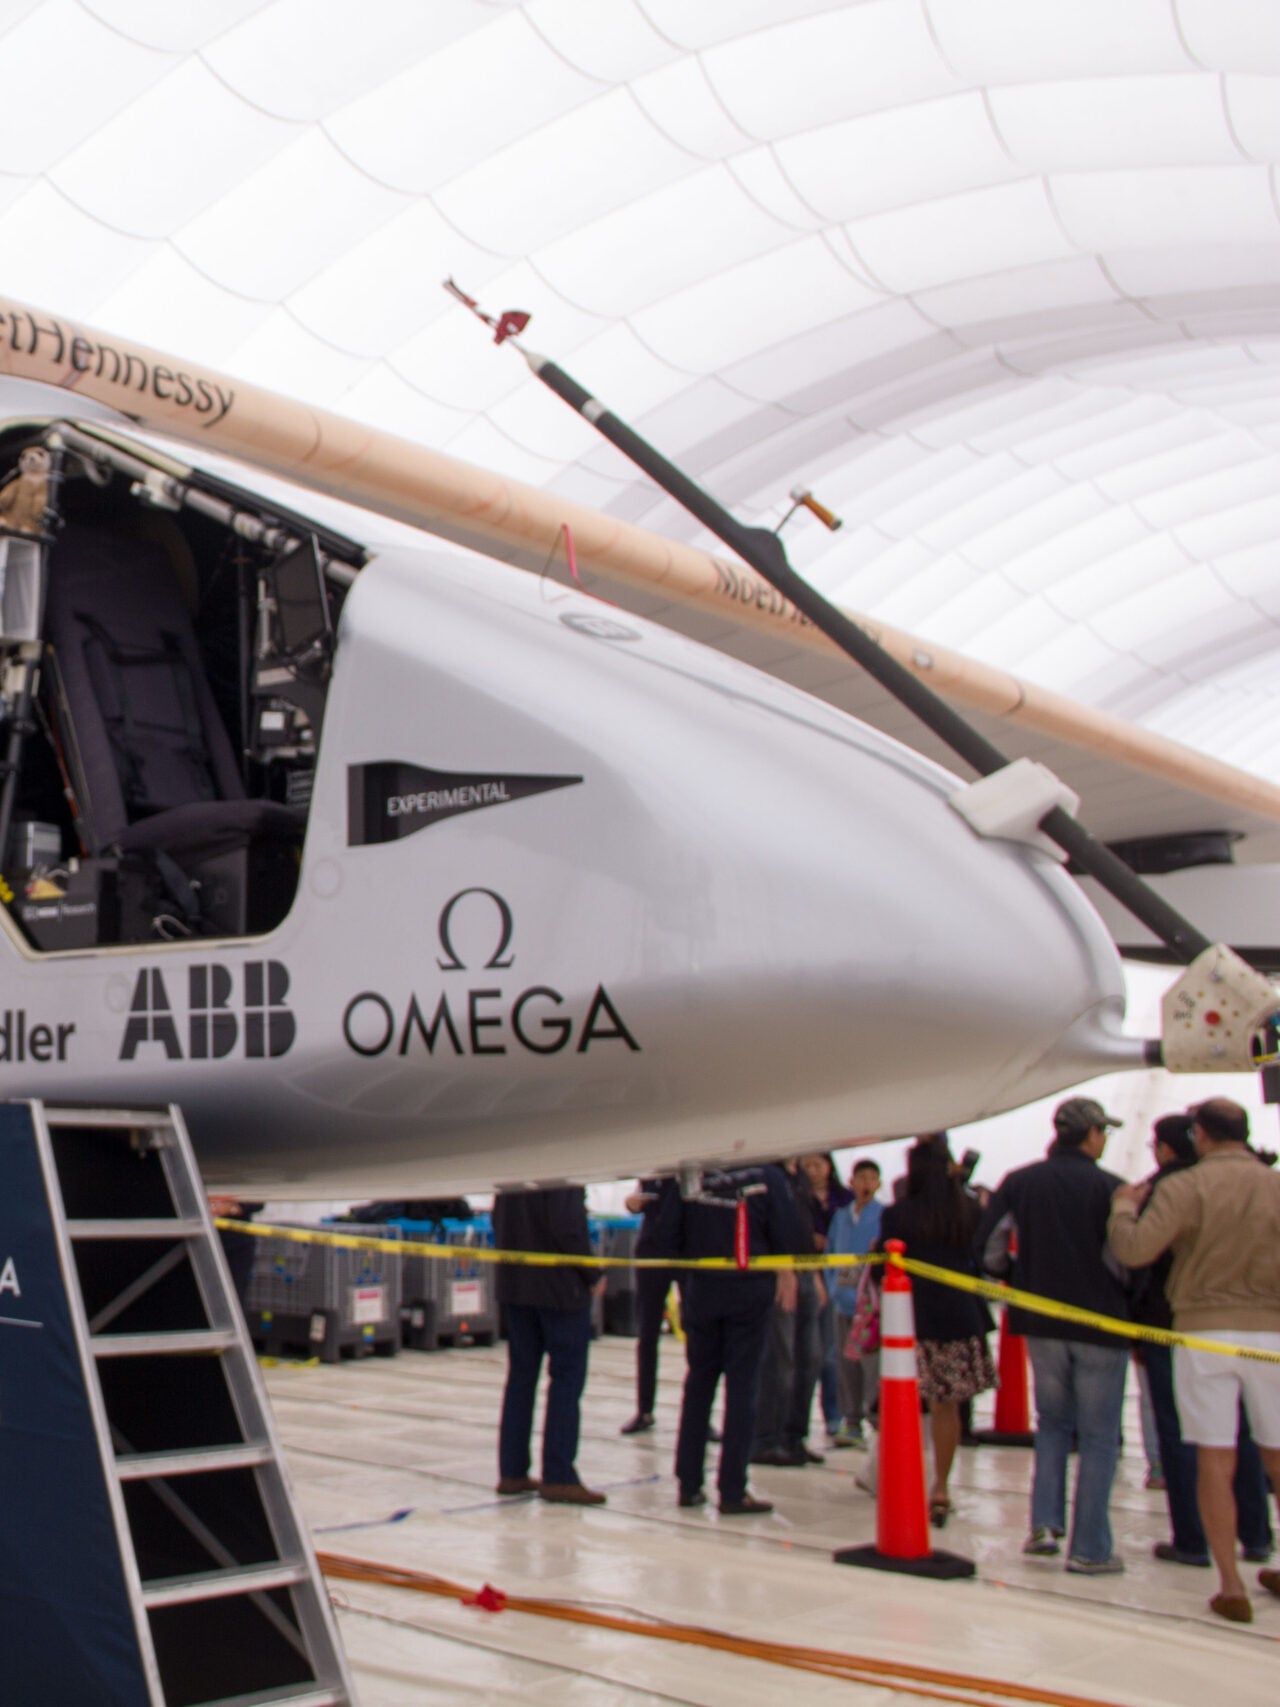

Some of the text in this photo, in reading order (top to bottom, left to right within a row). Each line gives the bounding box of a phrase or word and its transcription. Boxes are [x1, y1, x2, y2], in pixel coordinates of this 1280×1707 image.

[387, 781, 512, 818] EXPERIMENTAL
[118, 959, 298, 1061] ABB
[342, 983, 643, 1059] OMEGA
